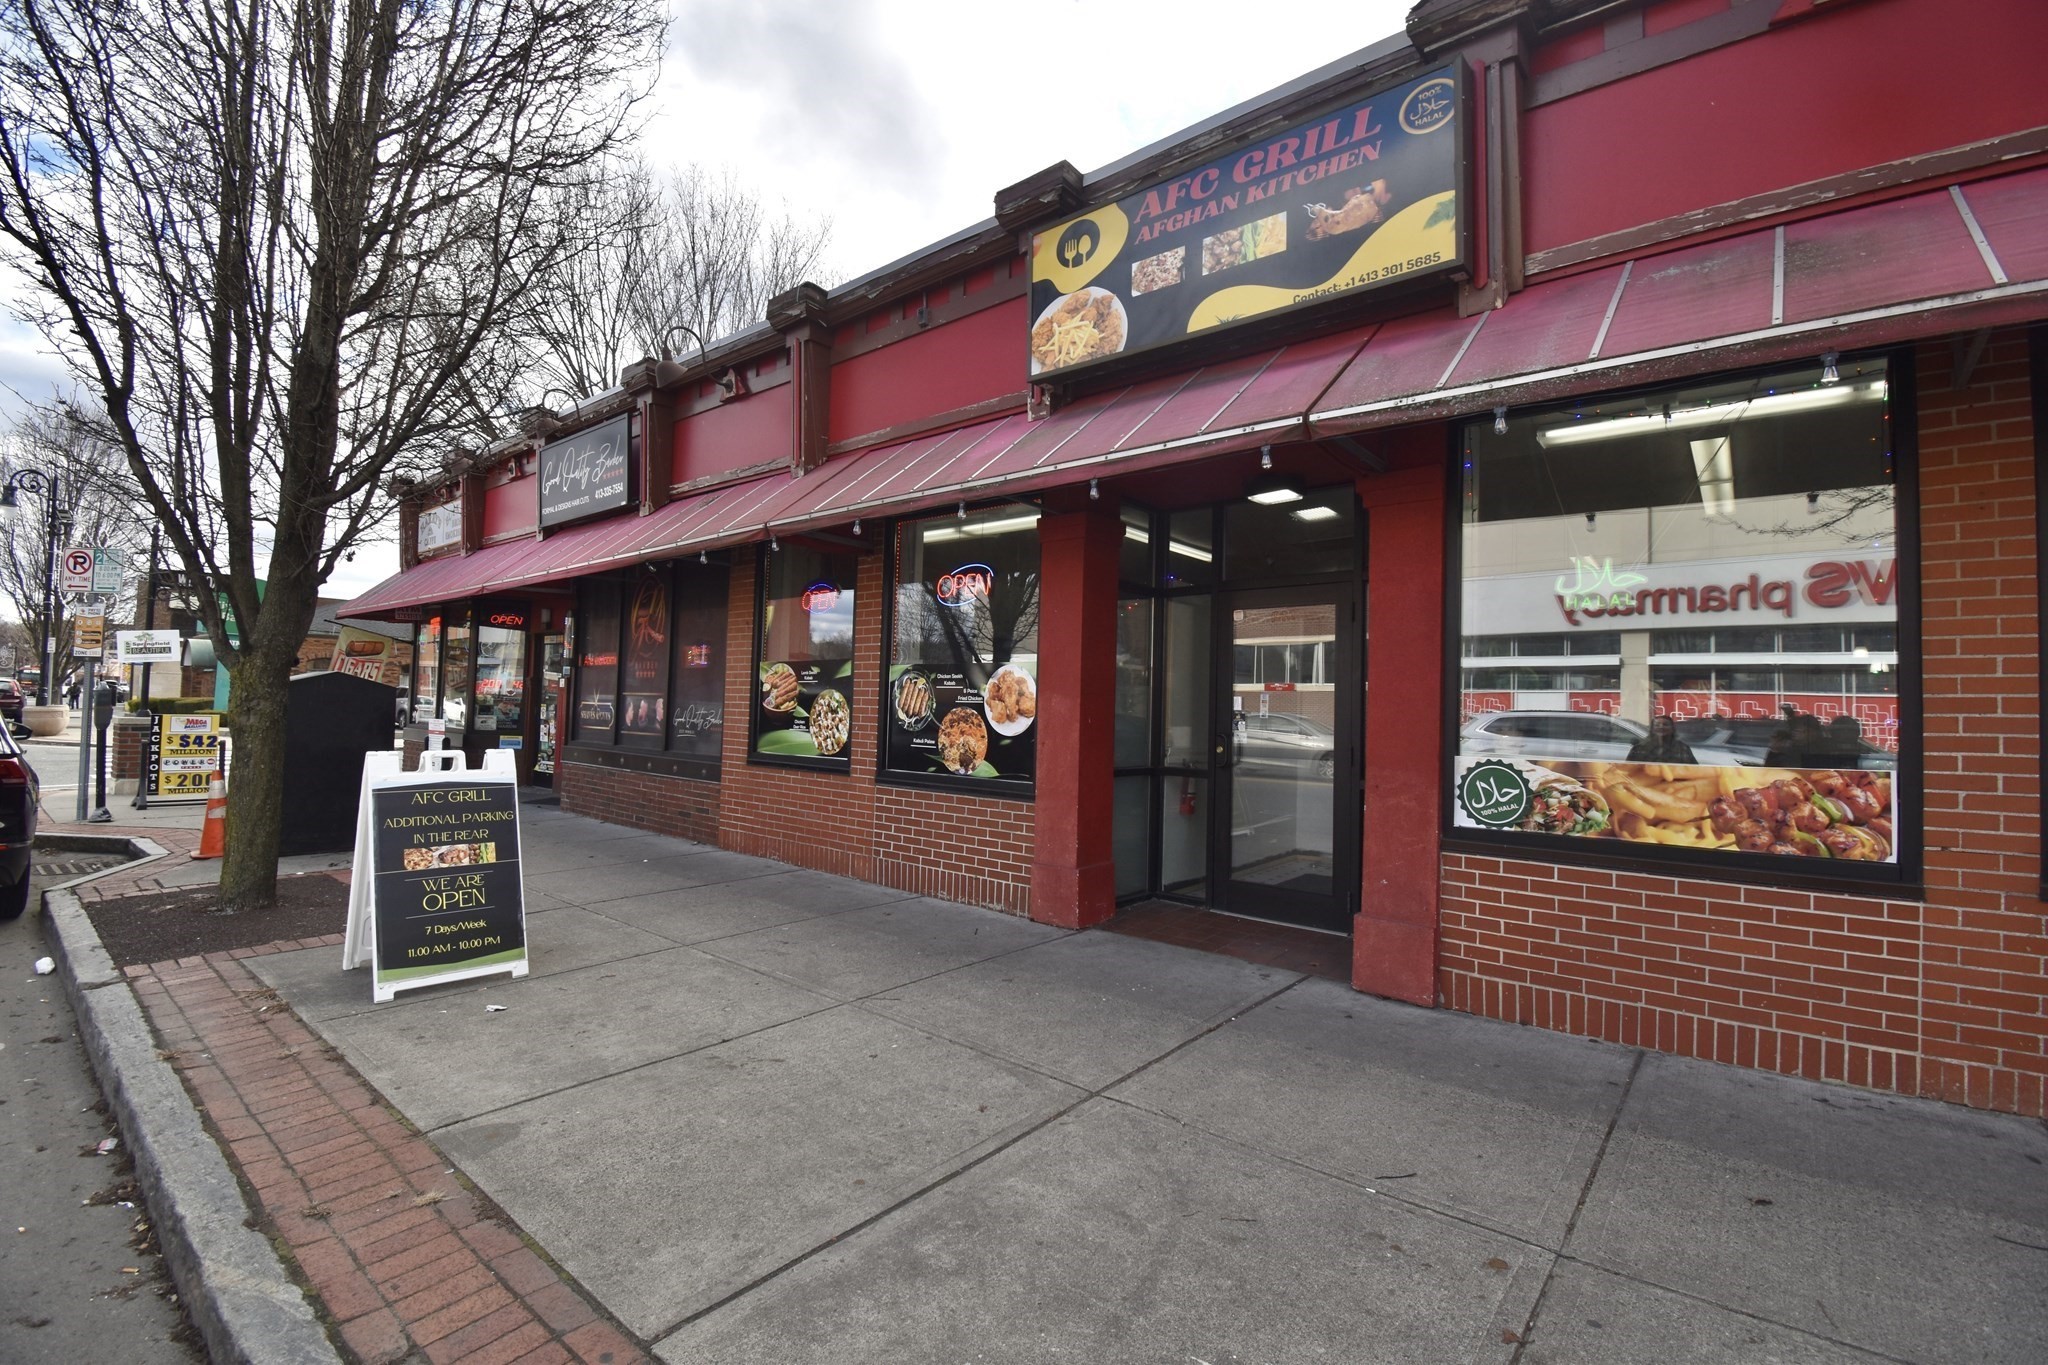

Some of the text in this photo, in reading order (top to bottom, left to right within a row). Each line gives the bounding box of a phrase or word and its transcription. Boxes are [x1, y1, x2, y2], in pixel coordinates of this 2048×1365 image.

[1418, 85, 1443, 101] 100%
[1410, 98, 1450, 120] حلال
[1415, 112, 1444, 126] HALAL
[1133, 106, 1383, 224] AFC GRILL
[1134, 140, 1383, 245] AFGHAN KITCHEN
[1293, 251, 1442, 304] Contact: +1 413 301 5685
[95, 553, 103, 564] 2
[937, 572, 992, 598] OPEN
[1555, 557, 1647, 594] حلال
[802, 589, 837, 610] OPEN
[1565, 592, 1636, 609] HALAL
[490, 615, 523, 625] OPEN
[131, 647, 171, 655] BEAUTIFUL
[334, 655, 382, 681] CIGARS
[179, 734, 218, 748] $42
[150, 716, 160, 790] JACKPOTS
[411, 789, 492, 805] AFC GRILL
[1472, 776, 1520, 808] حلال
[1481, 803, 1519, 816] 100% HALAL
[383, 810, 514, 829] ADDITIONAL PARKING
[413, 828, 489, 844] IN THE REAR
[422, 873, 485, 892] WE ARE
[422, 887, 486, 912] OPEN
[425, 919, 487, 935] 7 Days/Week
[408, 946, 430, 958] 11.00
[432, 943, 451, 954] AM
[459, 938, 482, 950] 10.00
[484, 935, 501, 946] PM
